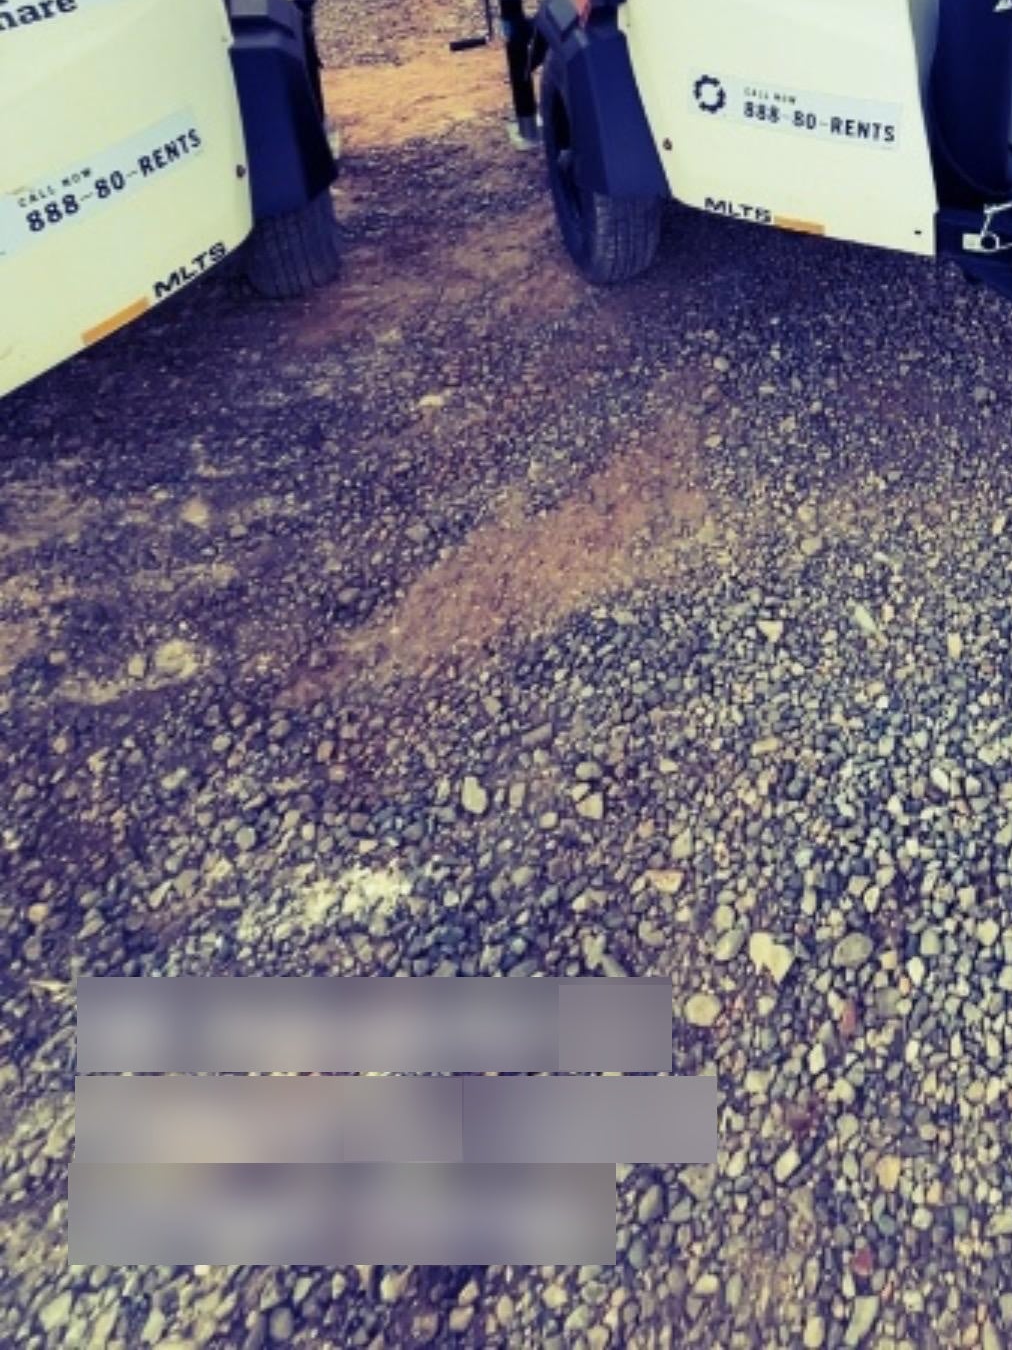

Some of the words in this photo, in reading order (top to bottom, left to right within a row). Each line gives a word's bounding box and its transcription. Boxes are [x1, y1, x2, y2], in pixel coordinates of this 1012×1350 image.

[743, 101, 895, 142] 888-80-RENTS
[26, 128, 202, 232] 888-80-RENTS
[704, 197, 772, 223] MLTS
[153, 241, 227, 298] MLTS
